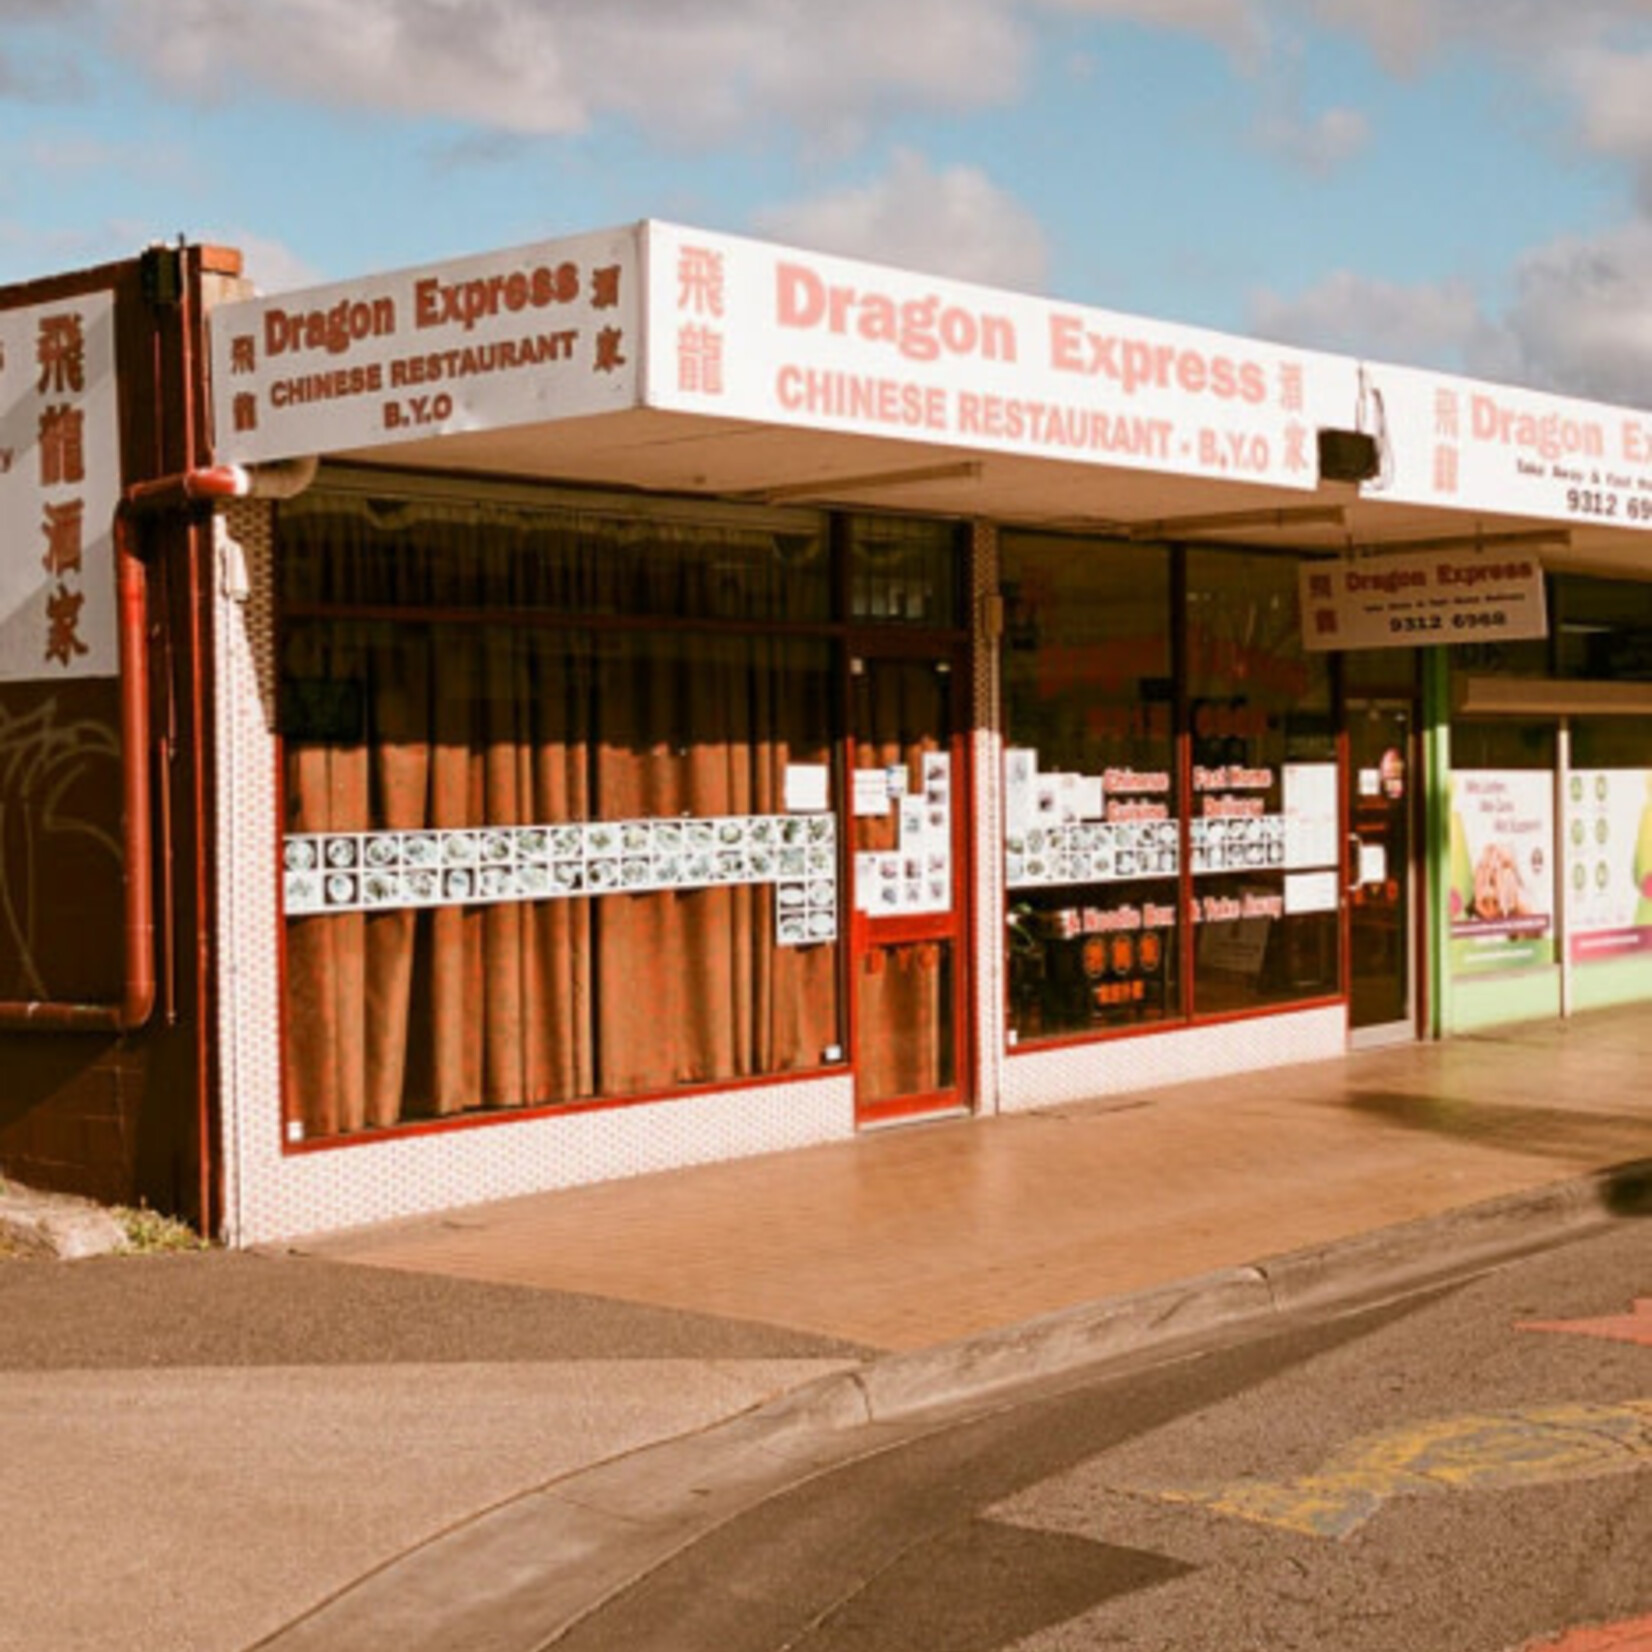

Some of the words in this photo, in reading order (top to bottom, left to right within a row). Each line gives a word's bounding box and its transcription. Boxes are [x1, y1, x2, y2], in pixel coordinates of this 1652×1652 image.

[264, 297, 395, 356] Dragon
[415, 261, 579, 330] Express
[677, 246, 724, 396] 飛龍
[775, 261, 1017, 364] Dragon
[1050, 315, 1267, 405] Express
[270, 363, 381, 408] CHINESE
[390, 329, 579, 387] RESTAURANT
[776, 364, 946, 430] CHINESE
[958, 392, 1174, 460] RESTAURANT
[1471, 395, 1603, 460] Dragon
[37, 313, 88, 667] 飛龍酒家
[1566, 488, 1617, 516] 9312
[1345, 571, 1427, 594] Dragon
[1436, 562, 1533, 586] Express
[1390, 615, 1442, 633] 9312
